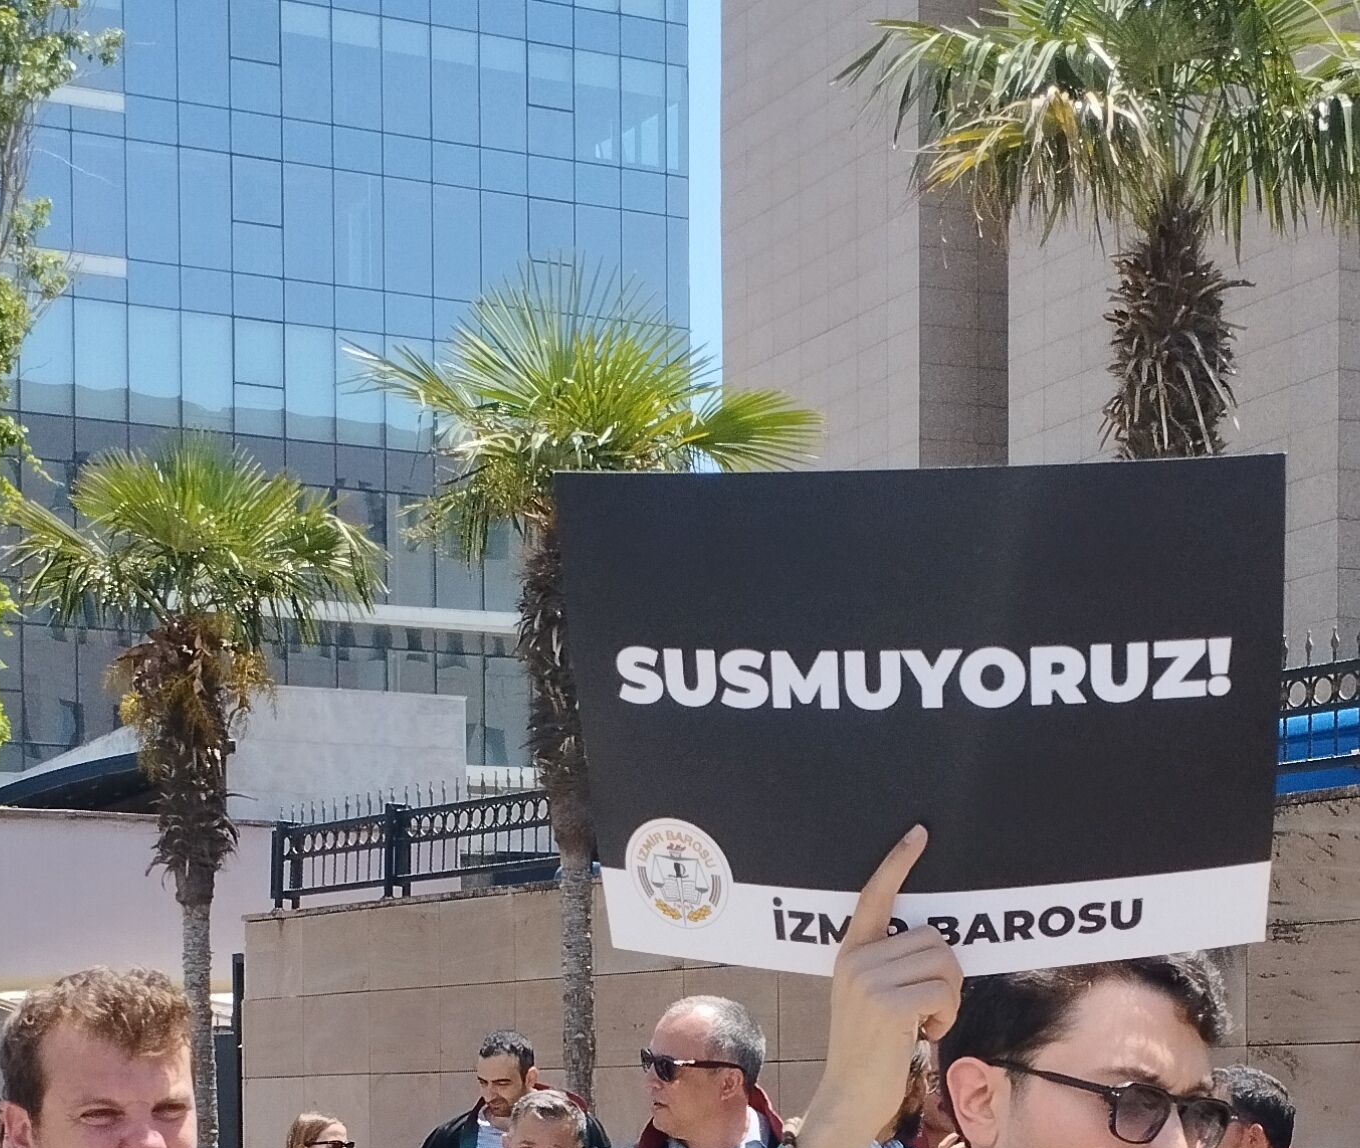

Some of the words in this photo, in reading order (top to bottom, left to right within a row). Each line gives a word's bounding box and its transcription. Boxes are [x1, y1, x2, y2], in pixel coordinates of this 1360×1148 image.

[616, 637, 1233, 711] SUSMUYORUZ!
[665, 830, 717, 868] BAROSU
[773, 896, 910, 946] İZM
[927, 897, 1144, 947] BAROSU
